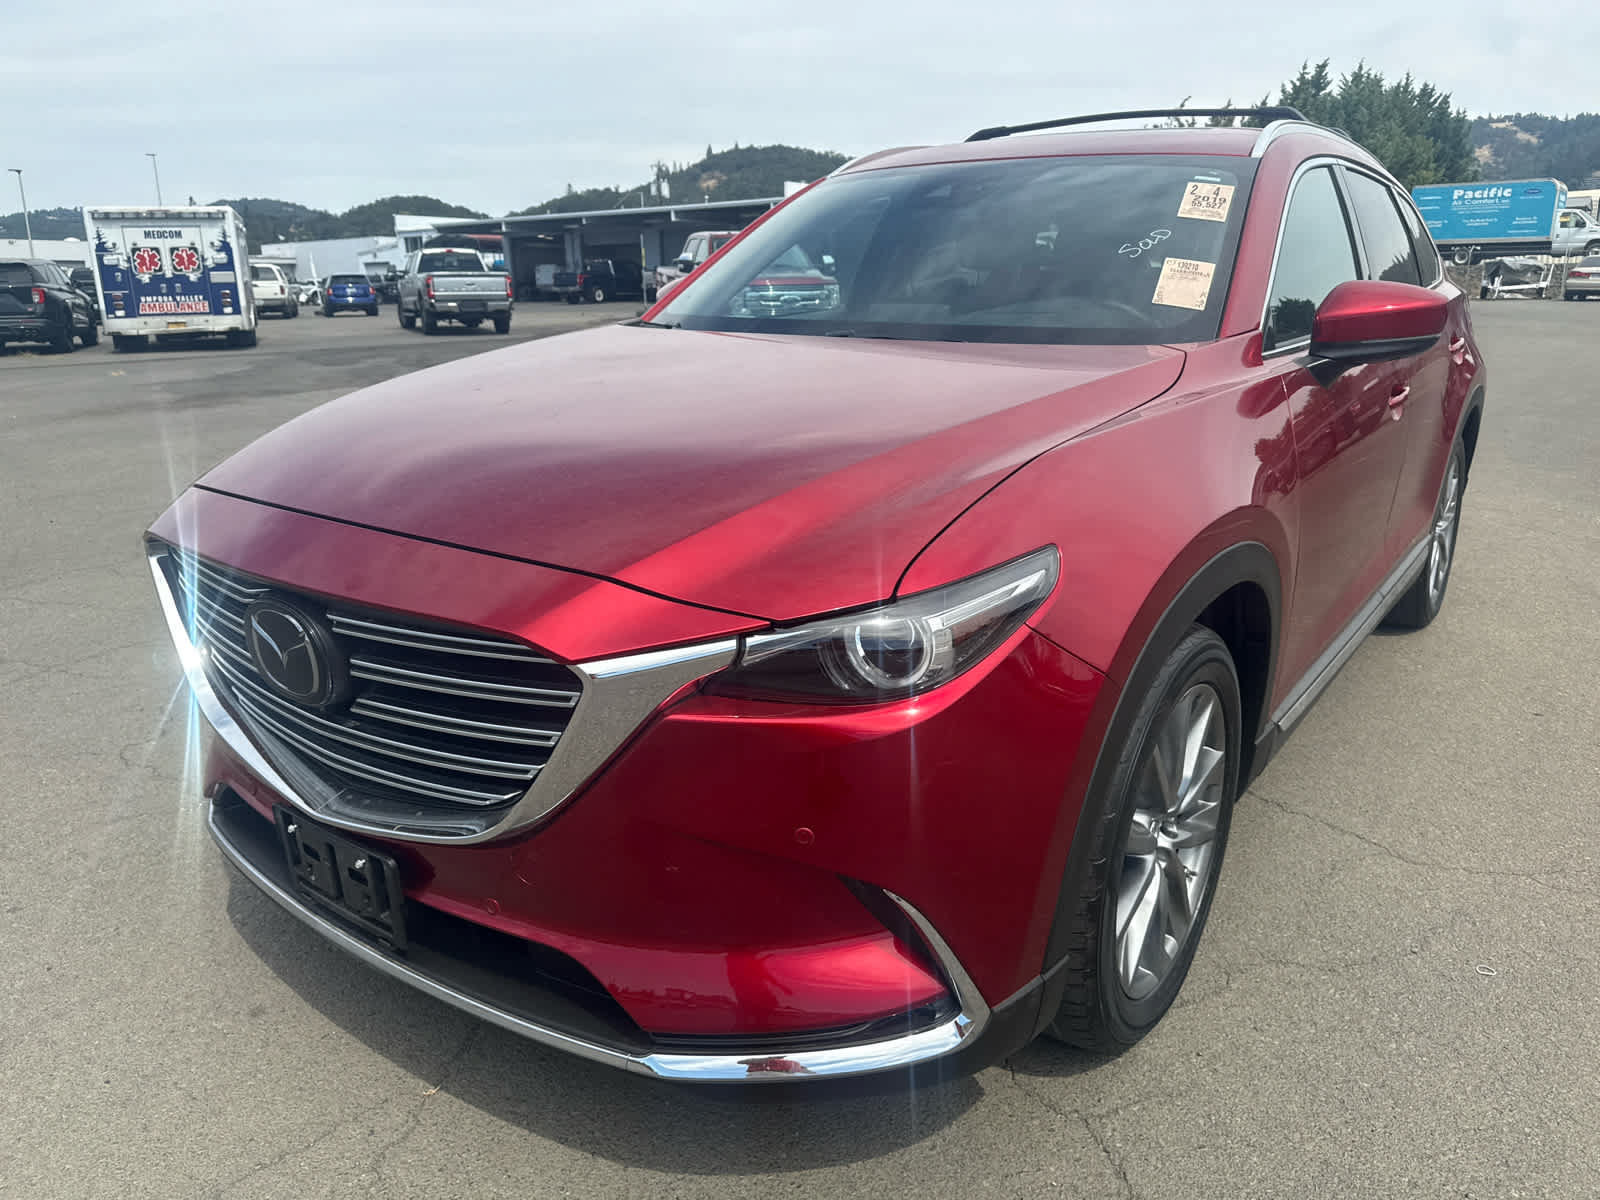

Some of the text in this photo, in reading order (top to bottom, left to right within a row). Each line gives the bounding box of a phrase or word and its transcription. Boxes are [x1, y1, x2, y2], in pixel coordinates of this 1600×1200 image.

[1190, 184, 1221, 197] 2 4
[1453, 187, 1513, 200] Pacific
[144, 230, 183, 239] MEDCOM
[140, 301, 208, 314] AMBULANCE
